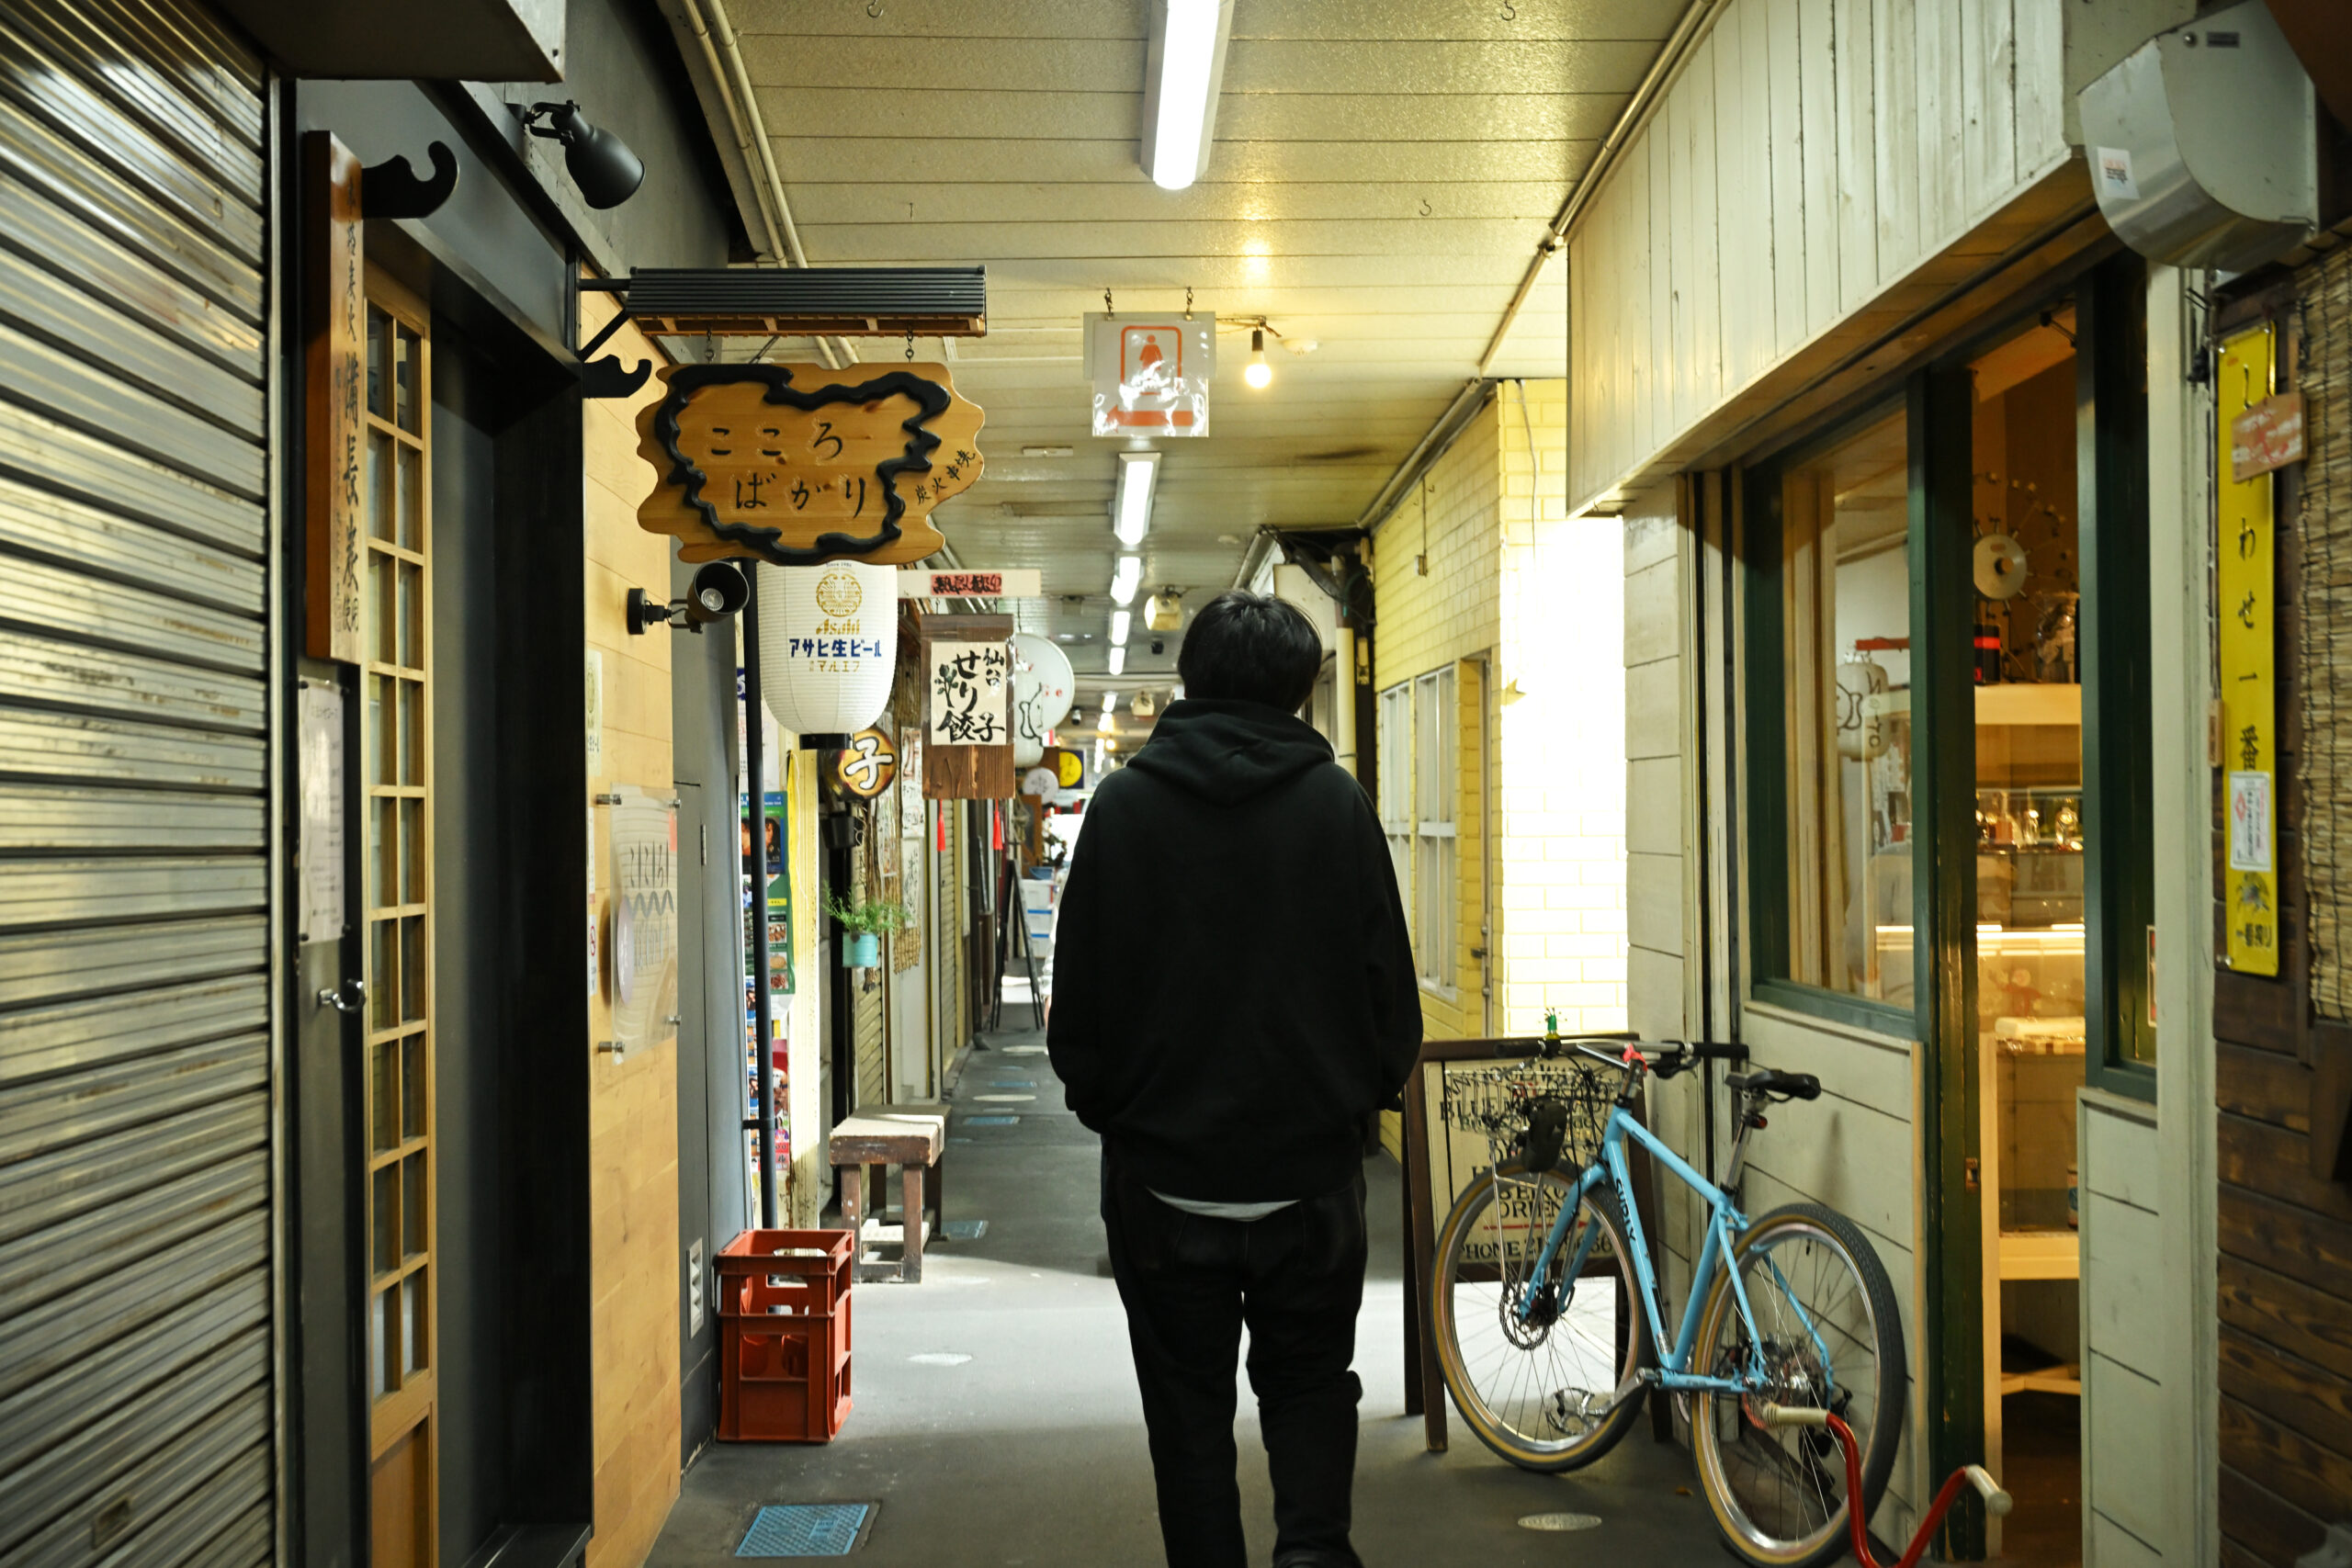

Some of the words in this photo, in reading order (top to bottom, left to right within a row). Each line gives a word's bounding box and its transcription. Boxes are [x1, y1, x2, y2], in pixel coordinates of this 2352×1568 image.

[711, 423, 843, 459] こころ
[735, 472, 865, 518] ばかり
[915, 449, 976, 505] 炭火串焼
[816, 618, 860, 635] Asahi
[788, 638, 882, 658] アサヒ生ビール
[844, 735, 894, 790] 子
